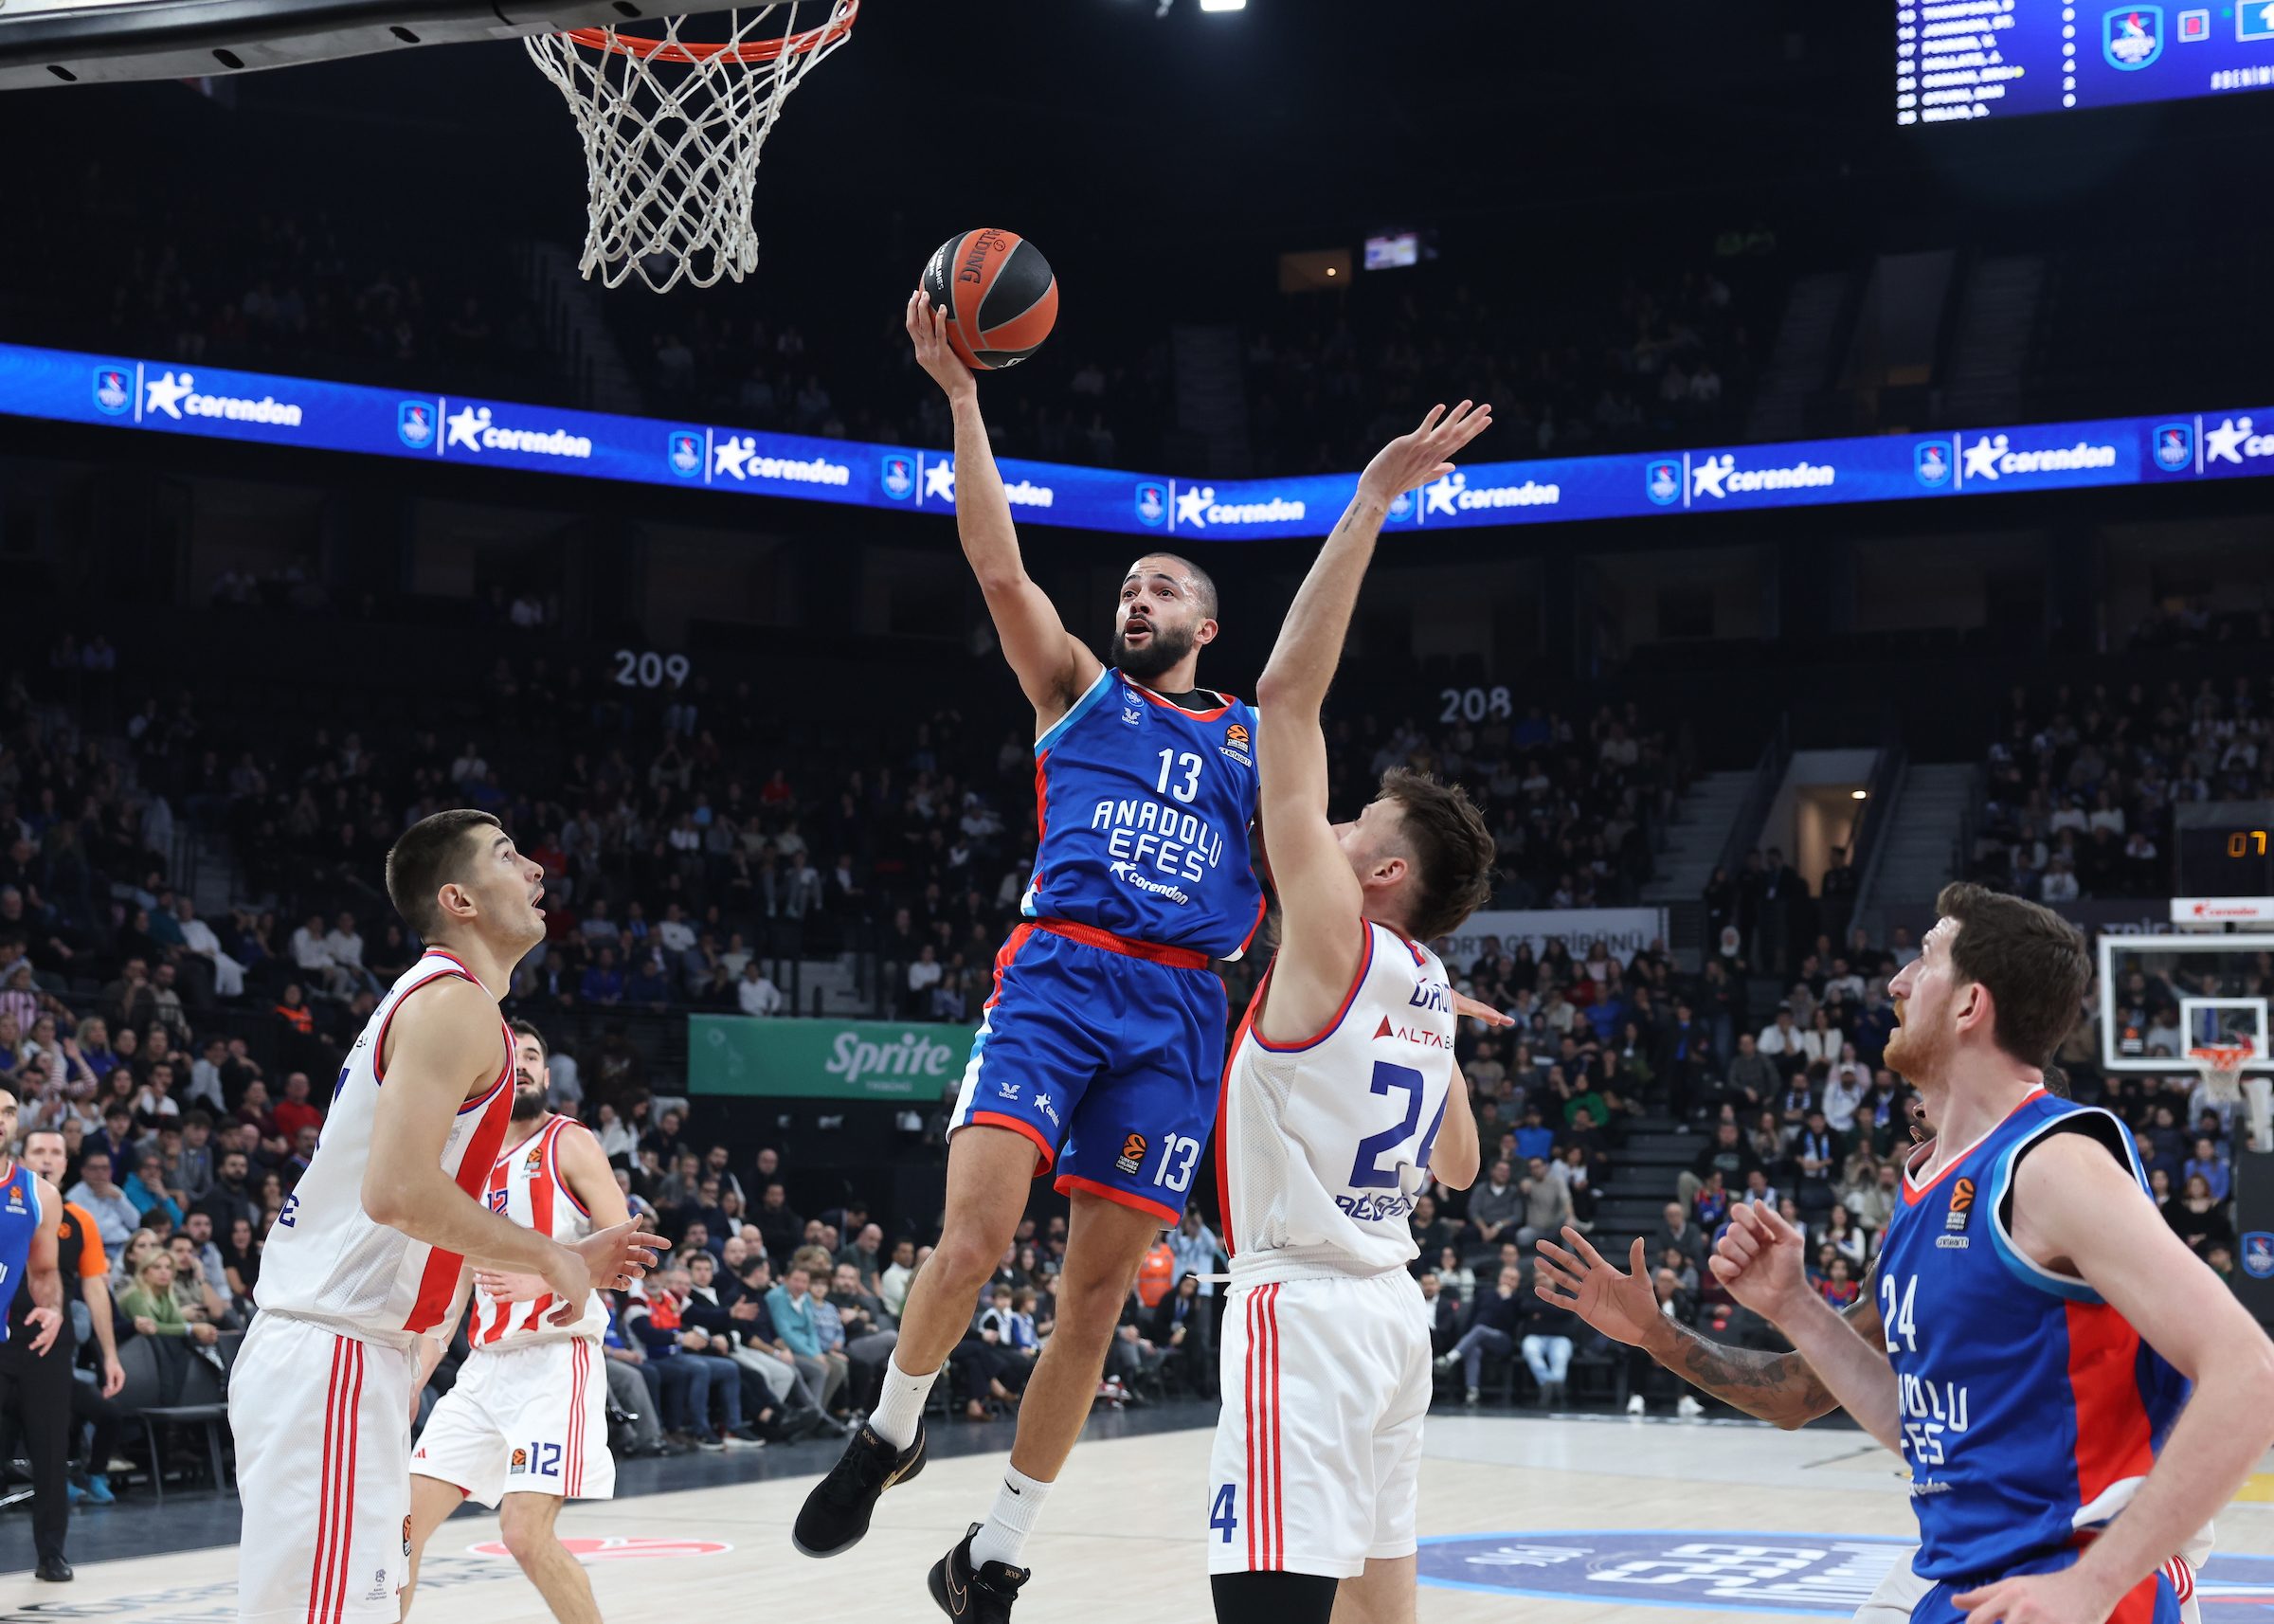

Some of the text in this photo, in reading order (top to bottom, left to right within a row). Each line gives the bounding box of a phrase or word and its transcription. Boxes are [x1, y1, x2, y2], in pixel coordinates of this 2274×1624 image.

[185, 392, 302, 426] corendon
[482, 426, 592, 459] corendon
[1999, 442, 2116, 474] corendon
[748, 456, 850, 486] corendon
[1727, 461, 1835, 492] corendon
[1206, 496, 1306, 524] corendon
[1458, 481, 1560, 510] corendon
[615, 649, 691, 688] 209
[1156, 748, 1203, 803] 13
[1092, 800, 1224, 869] ANADOLU
[1108, 828, 1206, 883] EFES
[1128, 873, 1189, 906] corendon
[825, 1031, 953, 1084] Sprite
[1153, 1131, 1200, 1193] 13
[1881, 1273, 1919, 1354] 24
[530, 1441, 562, 1477] 12
